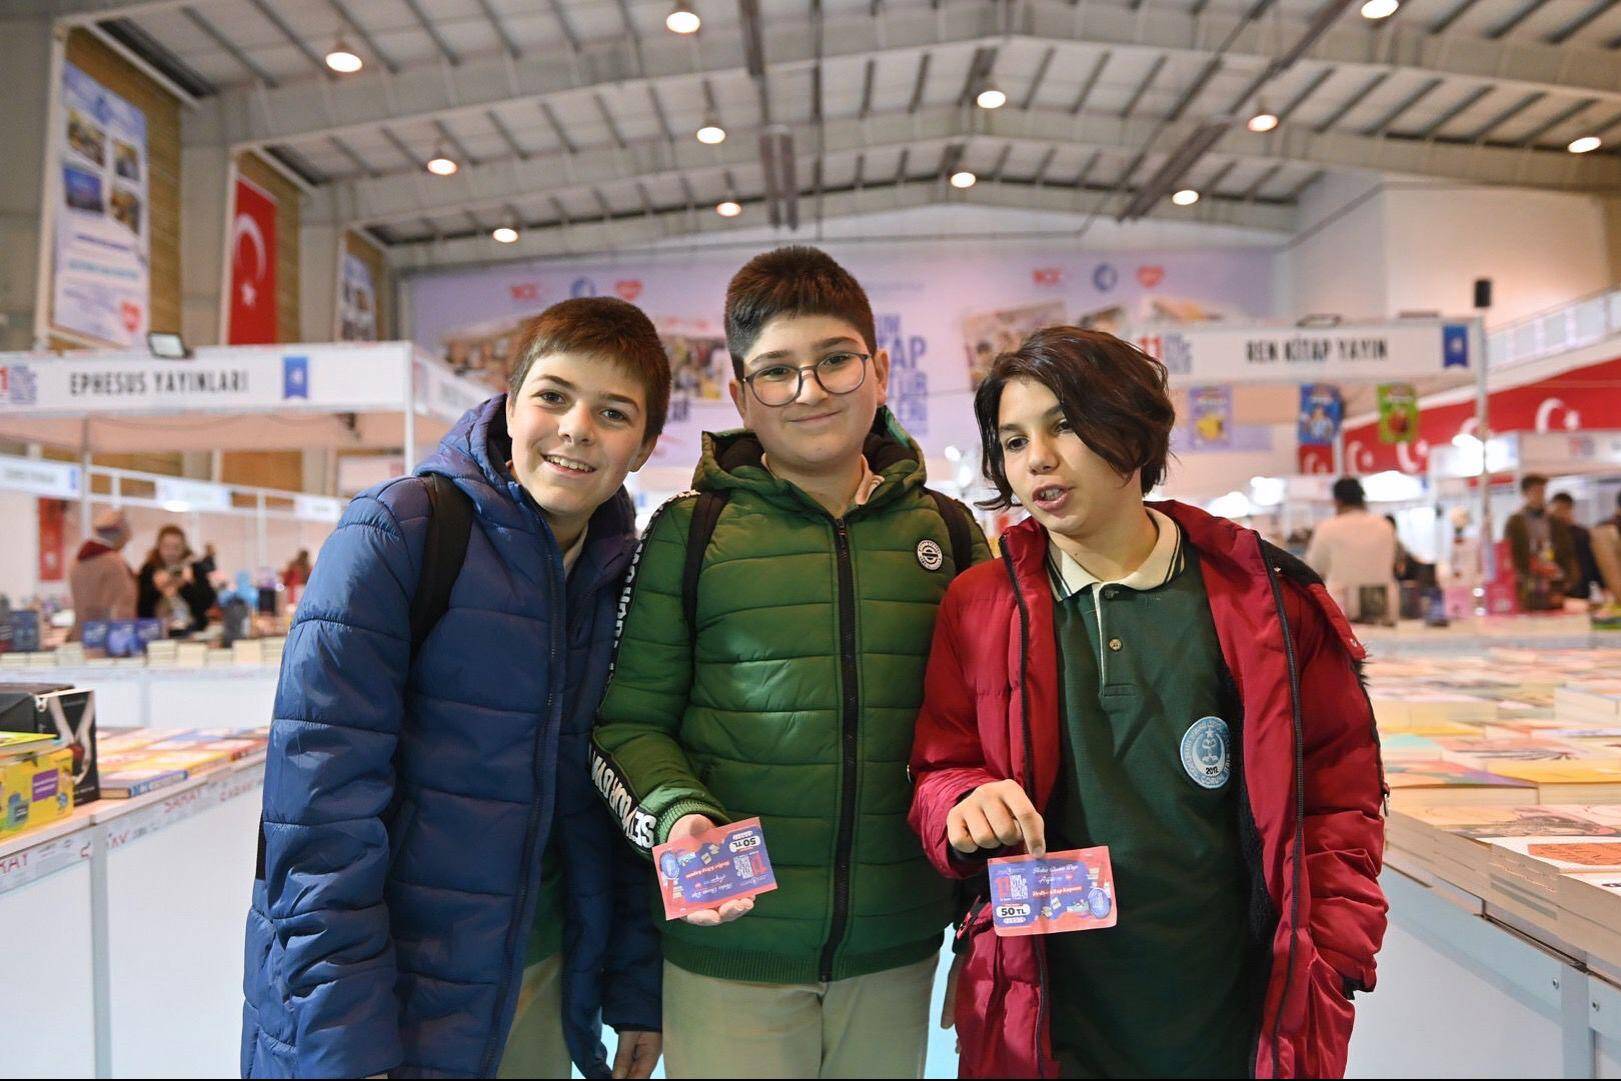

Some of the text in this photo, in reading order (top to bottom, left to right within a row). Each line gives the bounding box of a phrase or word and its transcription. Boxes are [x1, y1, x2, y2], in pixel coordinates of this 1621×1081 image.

[1337, 338, 1388, 361] YAYIN
[70, 370, 249, 396] EPHESUS YAYINLARI
[744, 837, 757, 847] 50
[1001, 907, 1015, 917] 50
